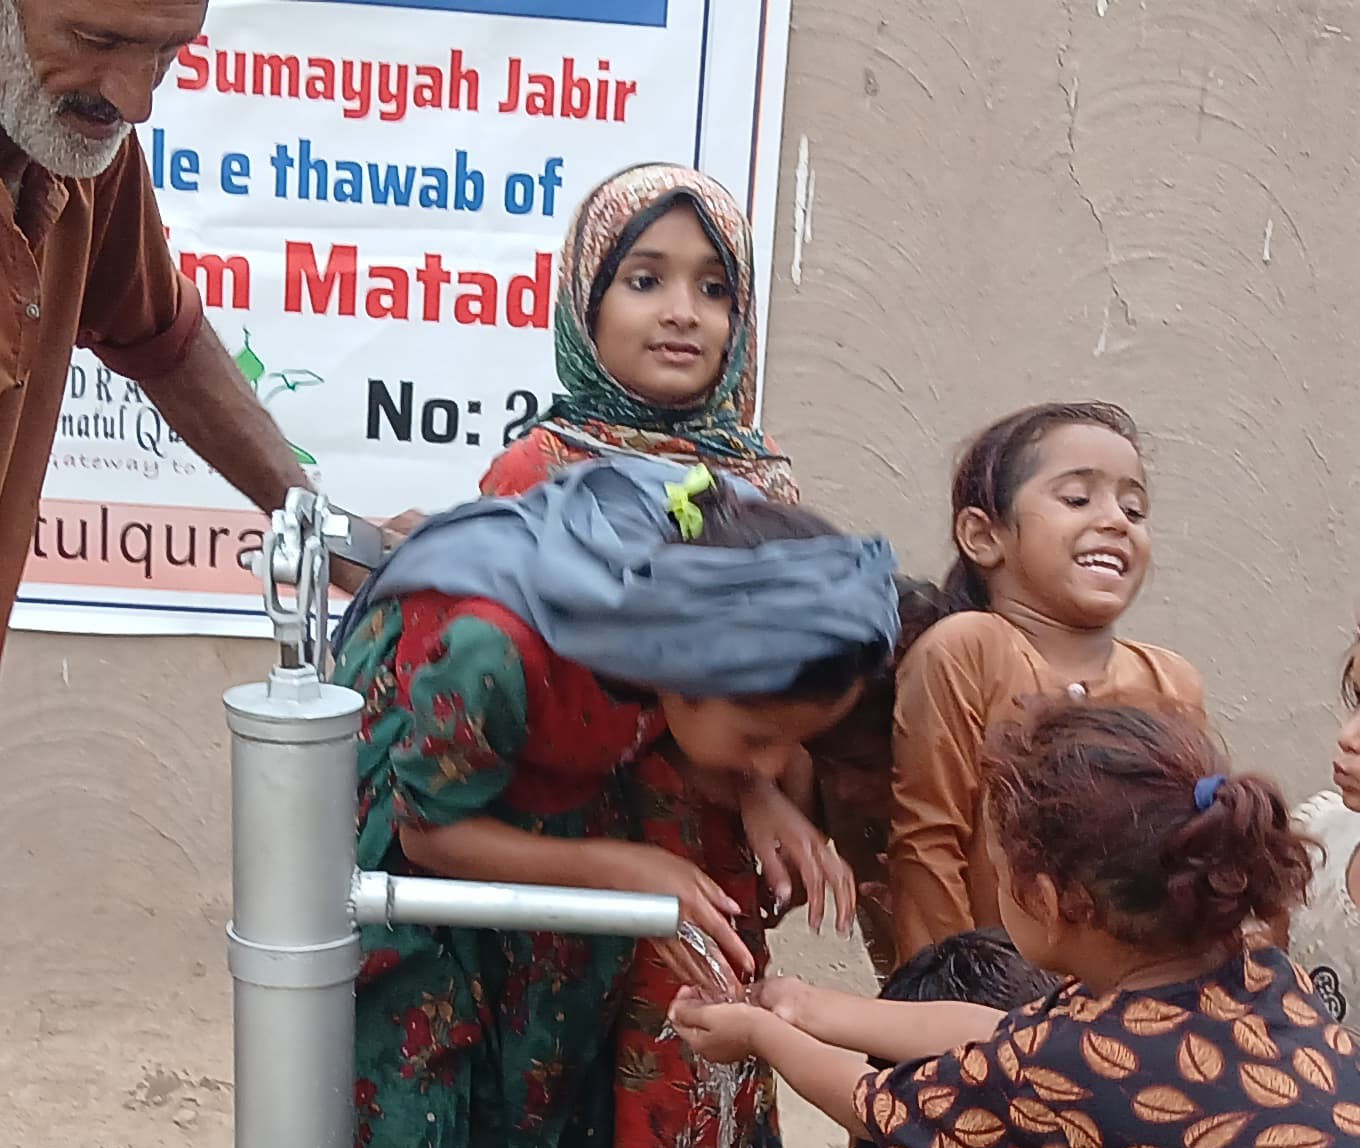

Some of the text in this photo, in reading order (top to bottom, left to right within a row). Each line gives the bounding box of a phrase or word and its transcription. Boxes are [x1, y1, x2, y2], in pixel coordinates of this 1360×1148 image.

[176, 34, 638, 123] Sumayyah Jabir
[220, 152, 251, 196] e
[270, 137, 485, 213] thawab
[504, 156, 565, 217] of
[284, 238, 554, 330] Matad
[366, 378, 481, 446] No:
